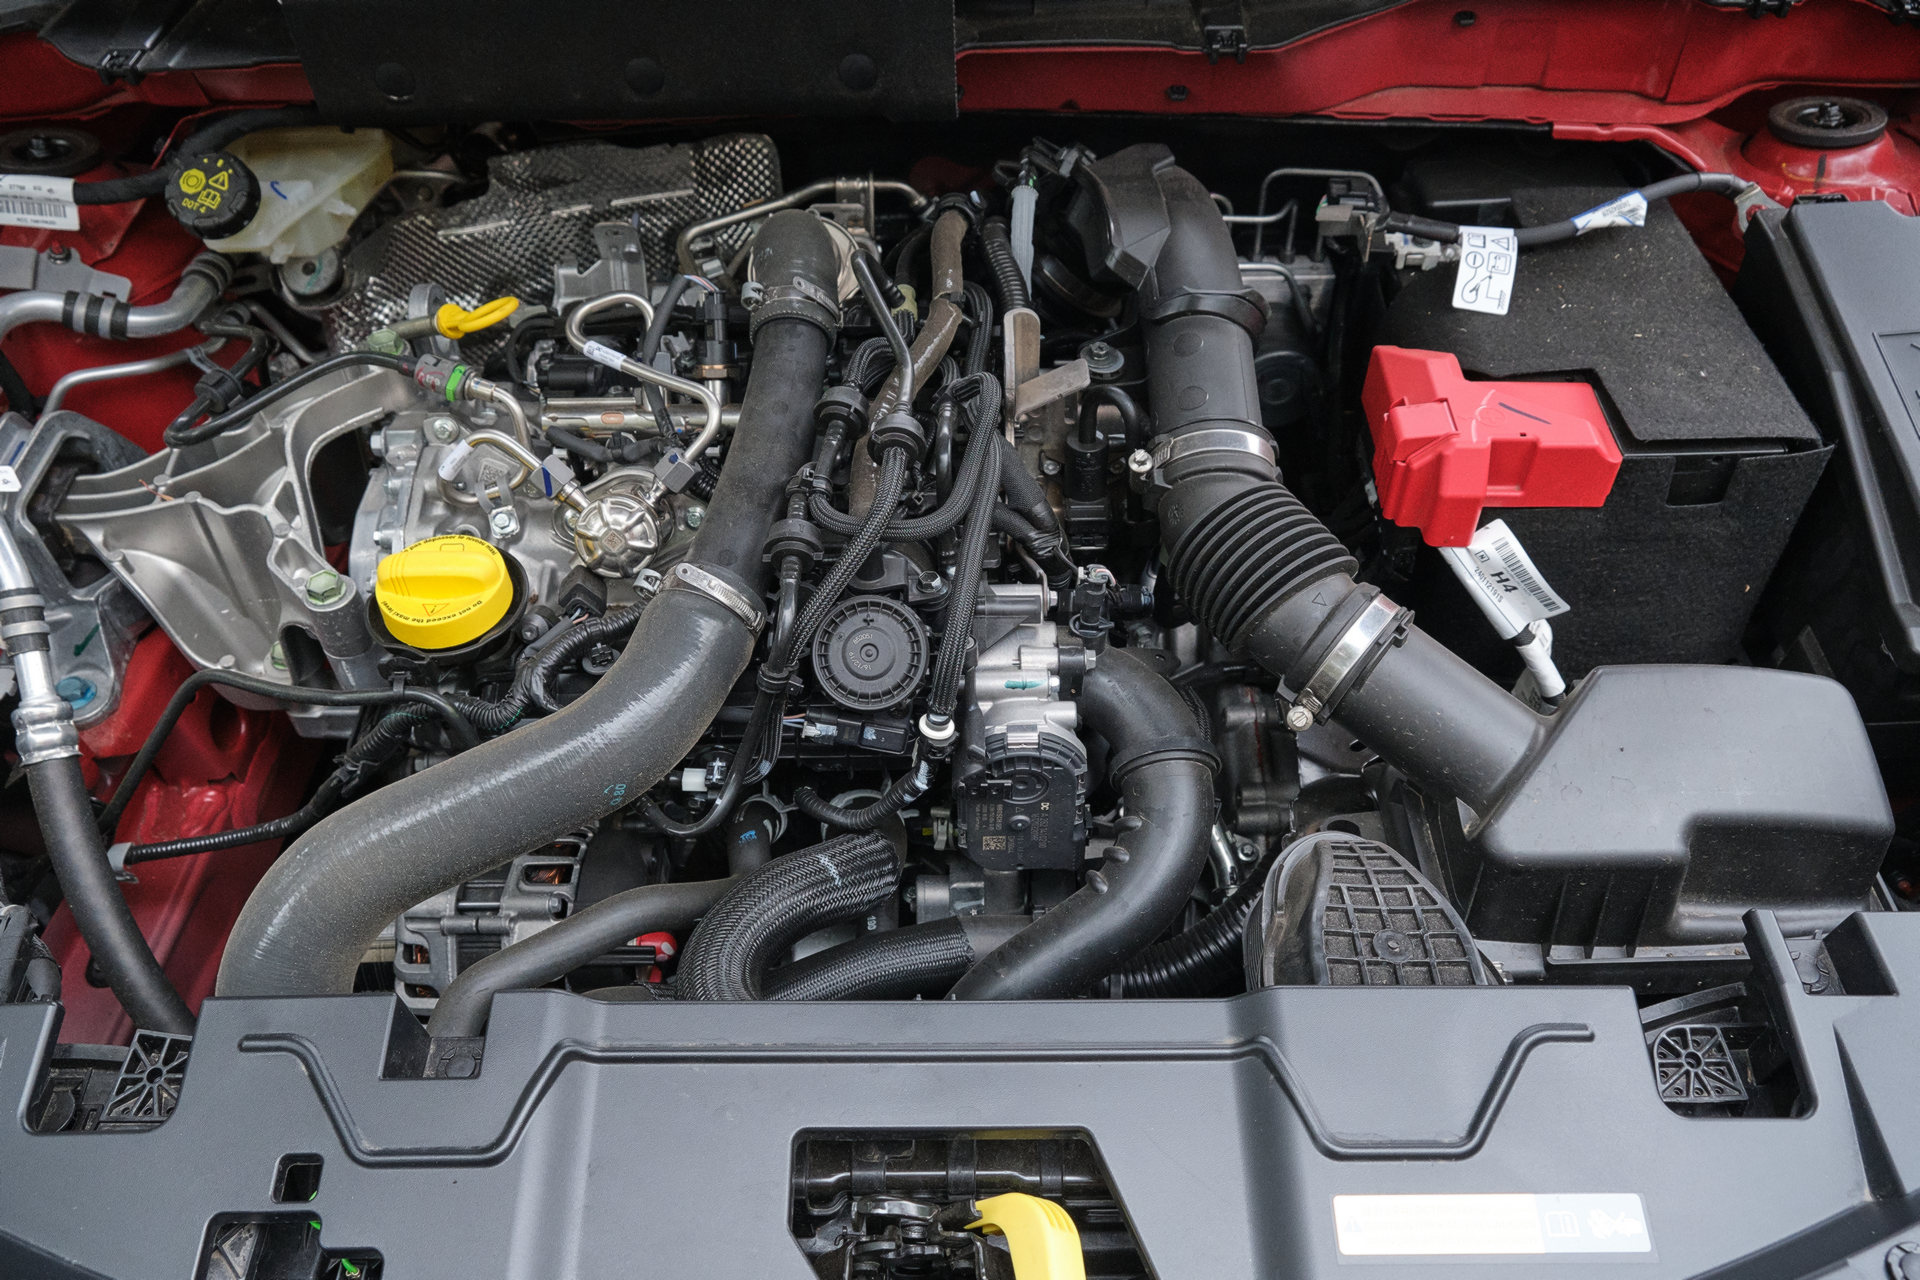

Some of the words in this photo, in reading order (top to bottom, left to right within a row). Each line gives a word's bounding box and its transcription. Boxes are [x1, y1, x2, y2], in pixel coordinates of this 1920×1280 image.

[181, 198, 199, 211] DOT
[466, 536, 485, 547] niveau
[485, 544, 497, 556] maxi
[1490, 571, 1518, 593] H4
[382, 601, 394, 613] level
[458, 605, 472, 615] not
[472, 600, 483, 608] Do
[393, 609, 410, 622] maxi
[426, 613, 458, 624] exceed
